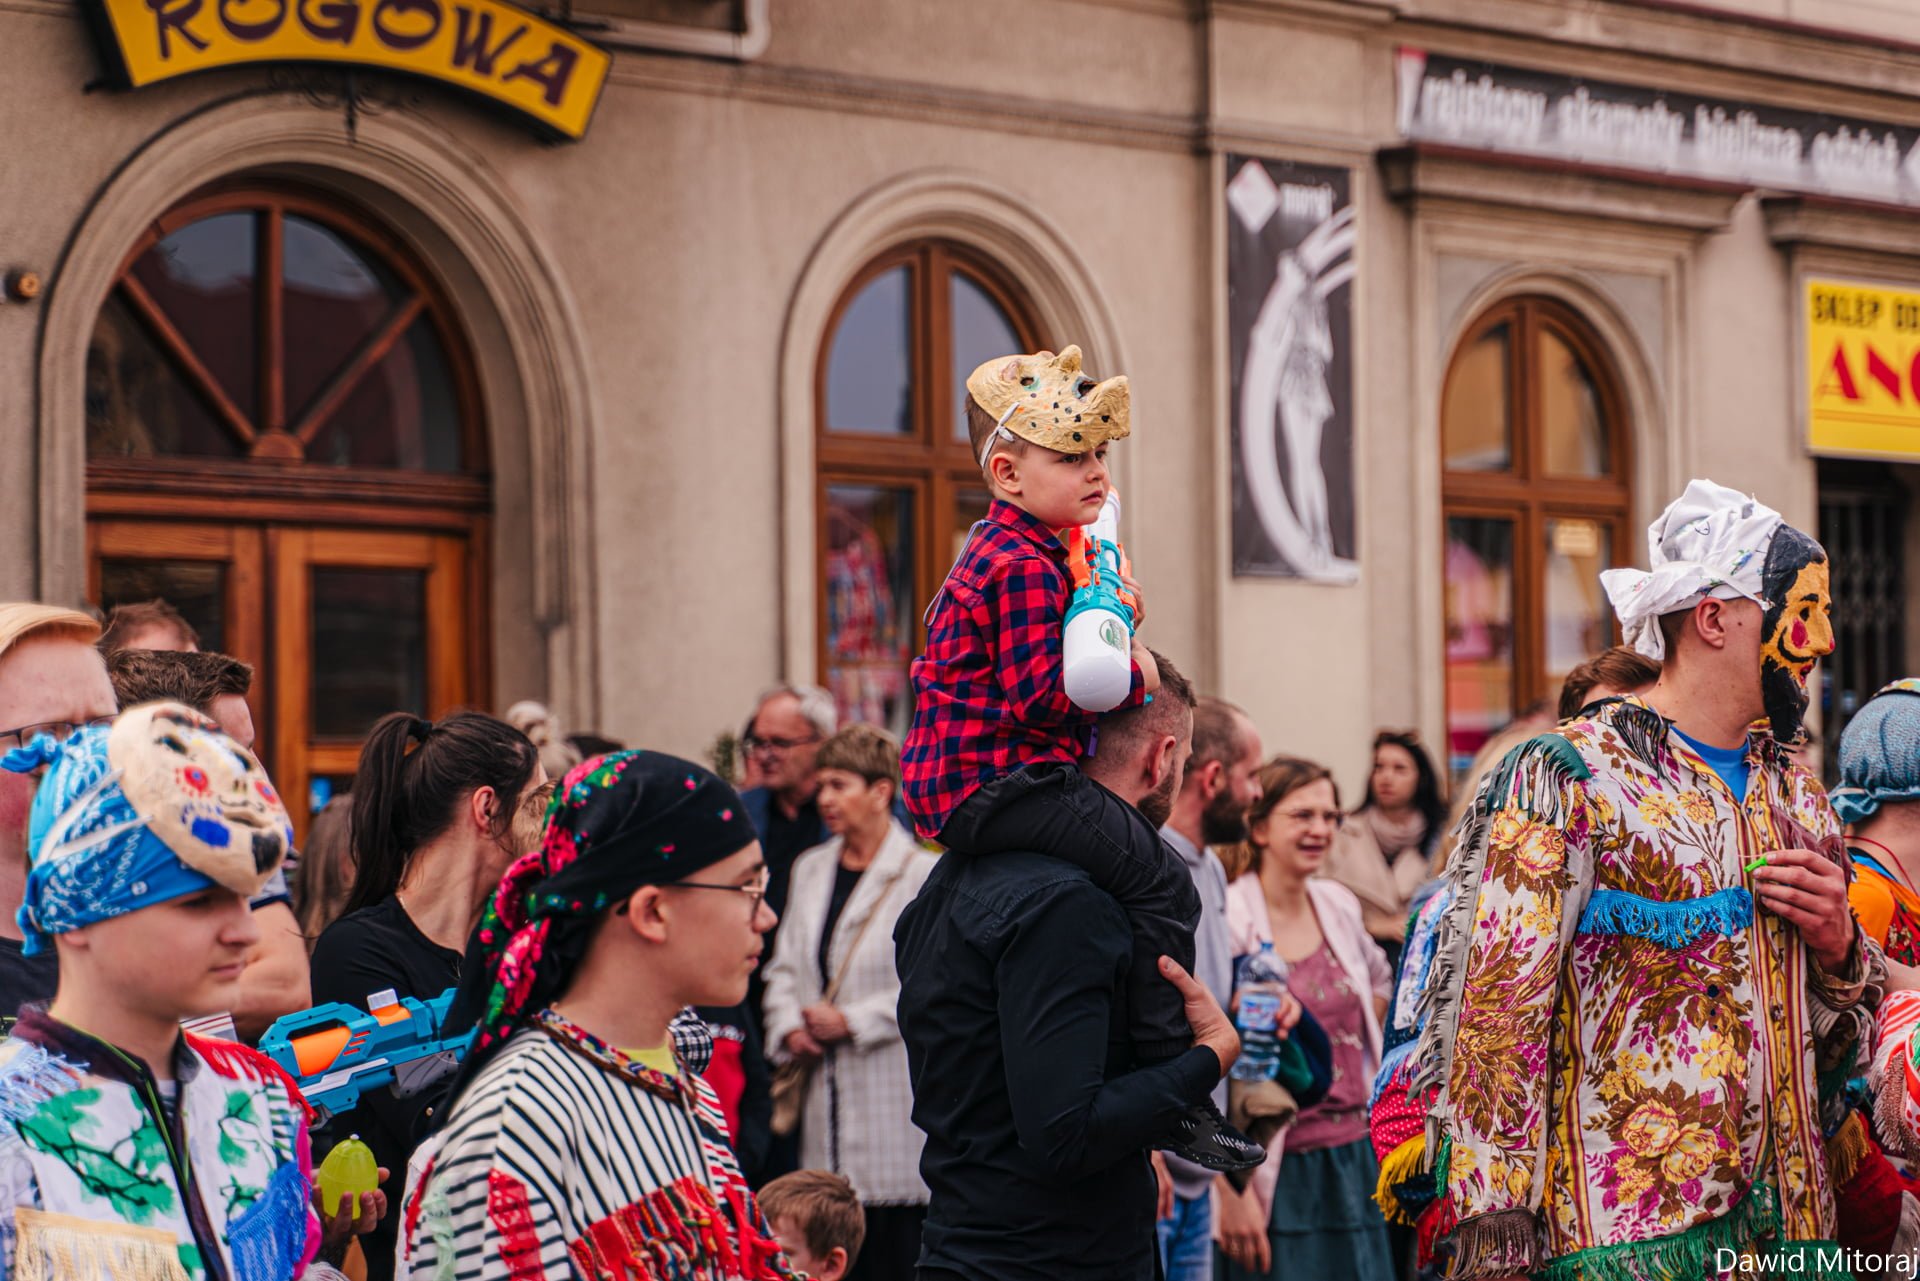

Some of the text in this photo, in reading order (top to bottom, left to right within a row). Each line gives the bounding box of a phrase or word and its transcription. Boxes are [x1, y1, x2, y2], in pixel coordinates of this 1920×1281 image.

[145, 0, 584, 106] ROGOWA
[1813, 293, 1880, 328] SKLEP
[1813, 337, 1920, 404] AN
